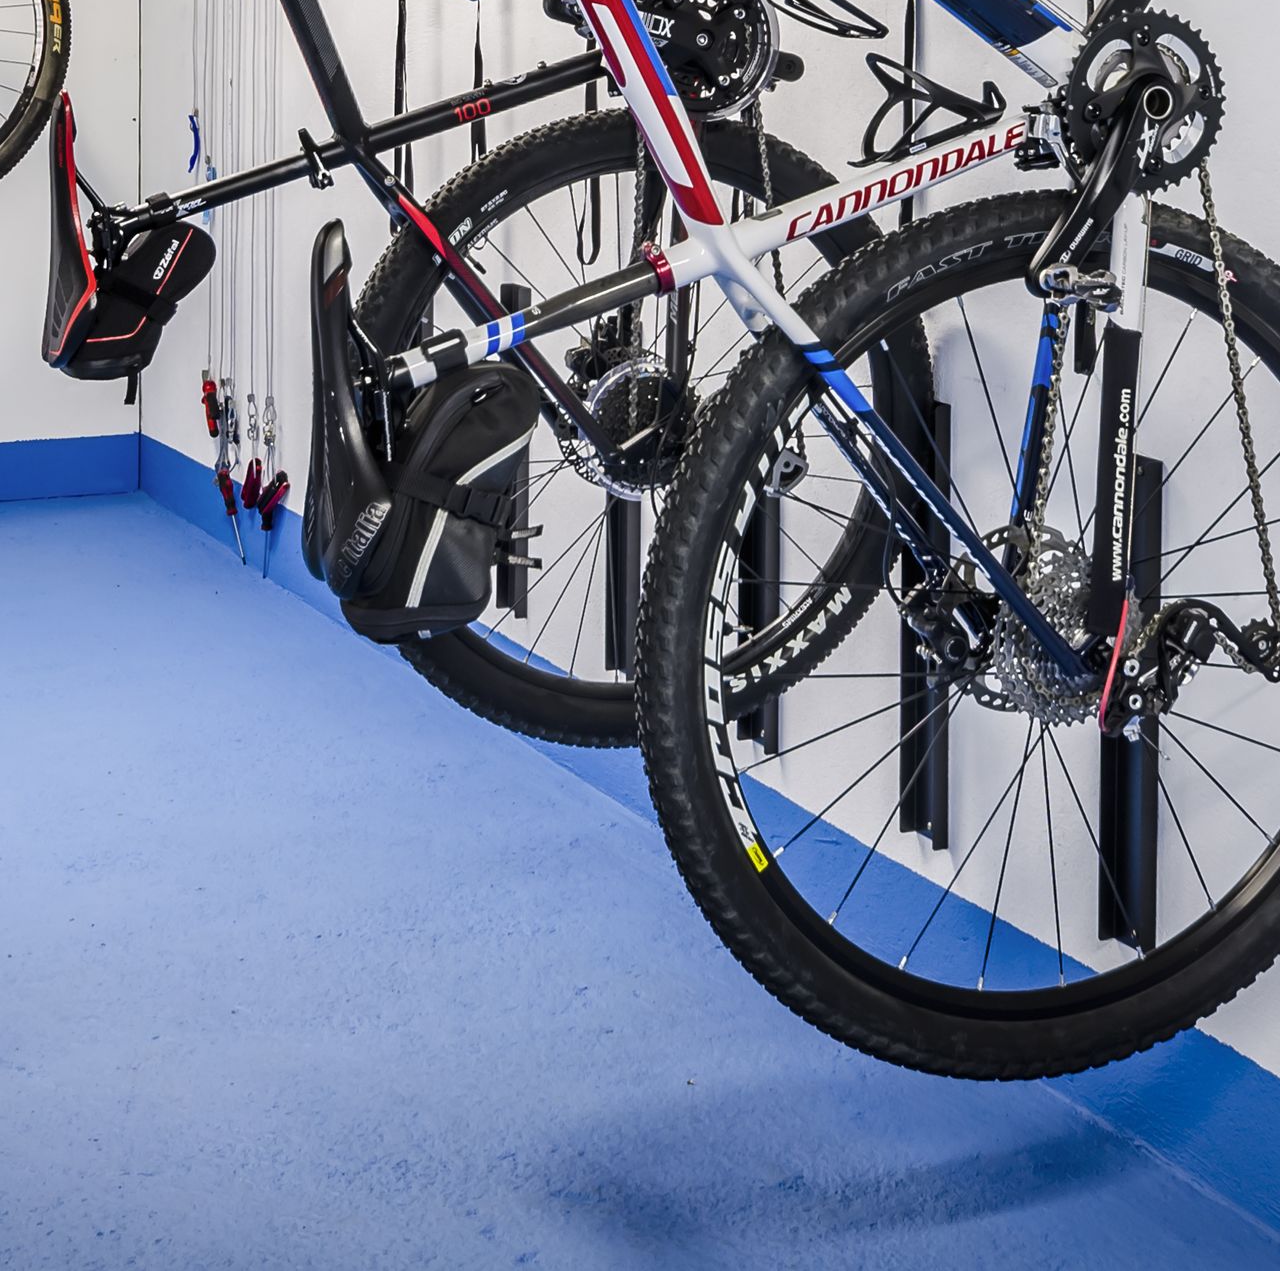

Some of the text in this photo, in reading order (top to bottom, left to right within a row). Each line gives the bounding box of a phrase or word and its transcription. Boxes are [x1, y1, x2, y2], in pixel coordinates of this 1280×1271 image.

[454, 98, 491, 122] 100
[786, 122, 1026, 242] CANNONDALE
[886, 240, 993, 303] FAST
[1175, 248, 1202, 267] GRID
[1112, 388, 1132, 581] www.cannondale.com
[730, 584, 852, 694] MAXXIS
